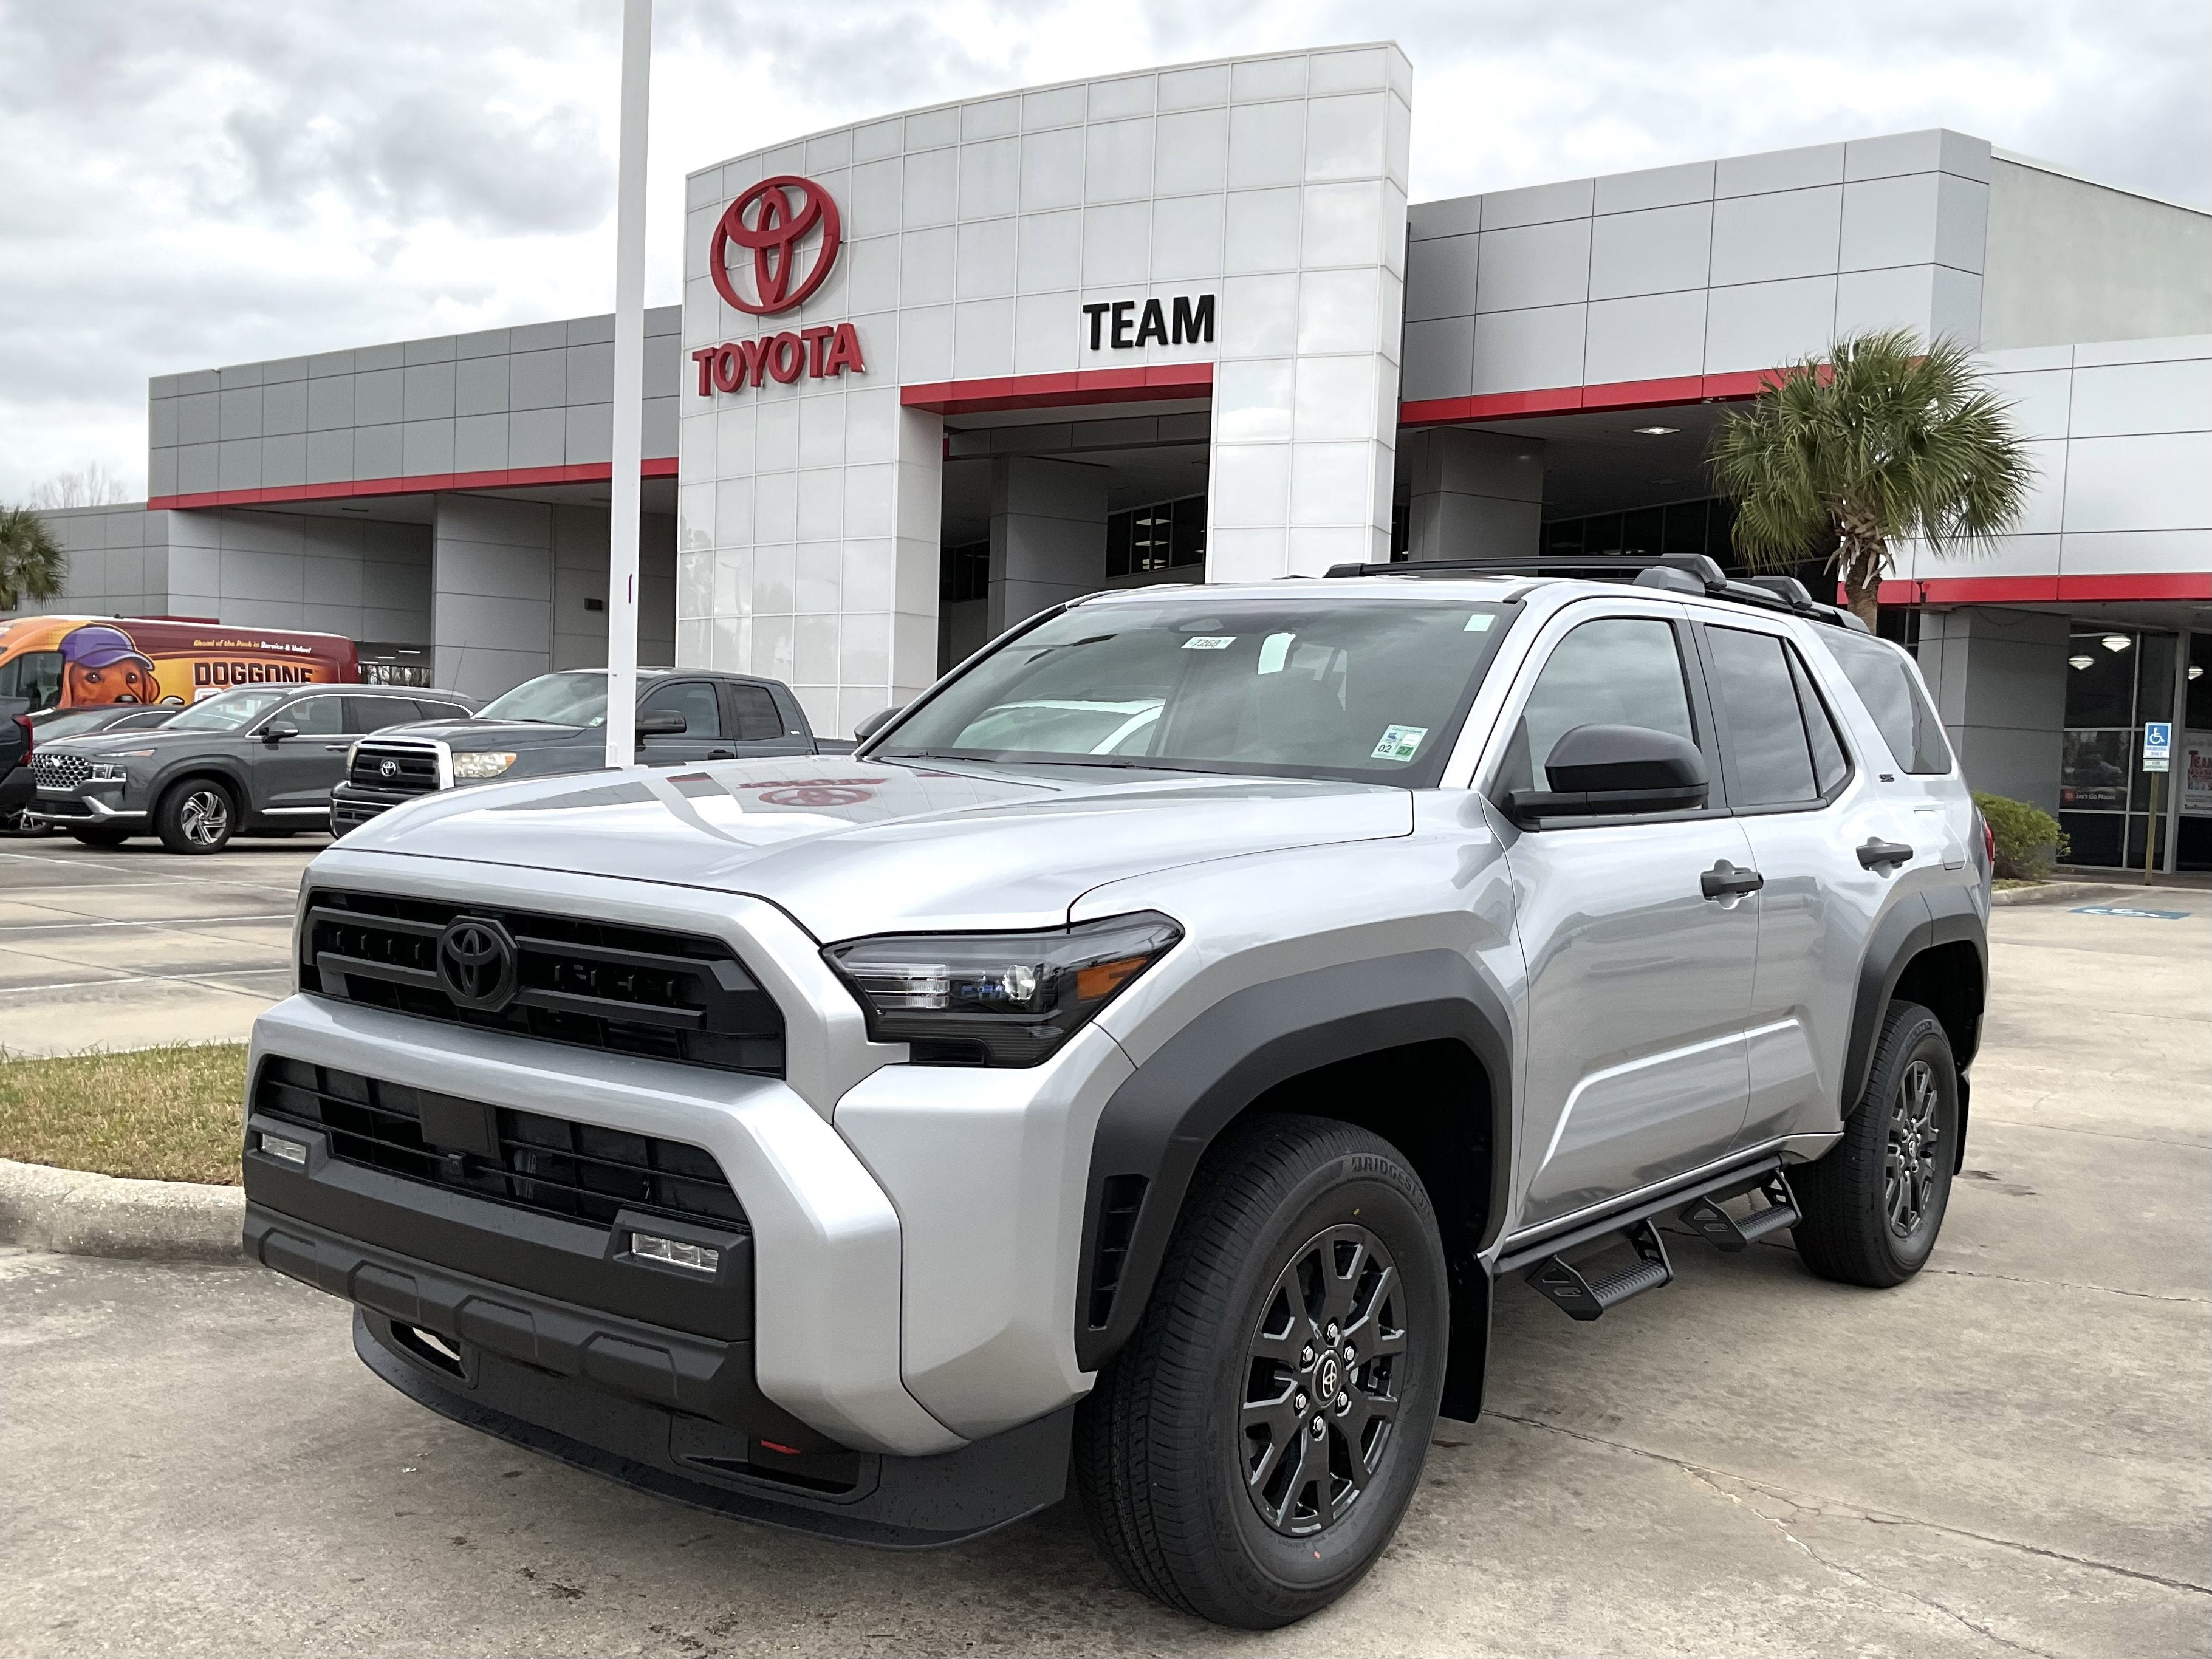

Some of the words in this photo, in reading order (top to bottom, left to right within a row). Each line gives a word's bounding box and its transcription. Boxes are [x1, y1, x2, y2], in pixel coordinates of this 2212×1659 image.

[1082, 293, 1214, 350] TEAM
[692, 323, 865, 397] TOYOTA
[261, 641, 284, 651] Service
[292, 645, 312, 654] Value!
[194, 662, 313, 686] DOGGONE
[1378, 744, 1392, 753] 02
[1397, 746, 1412, 755] 27
[1351, 1155, 1431, 1217] BRIDGESTO
